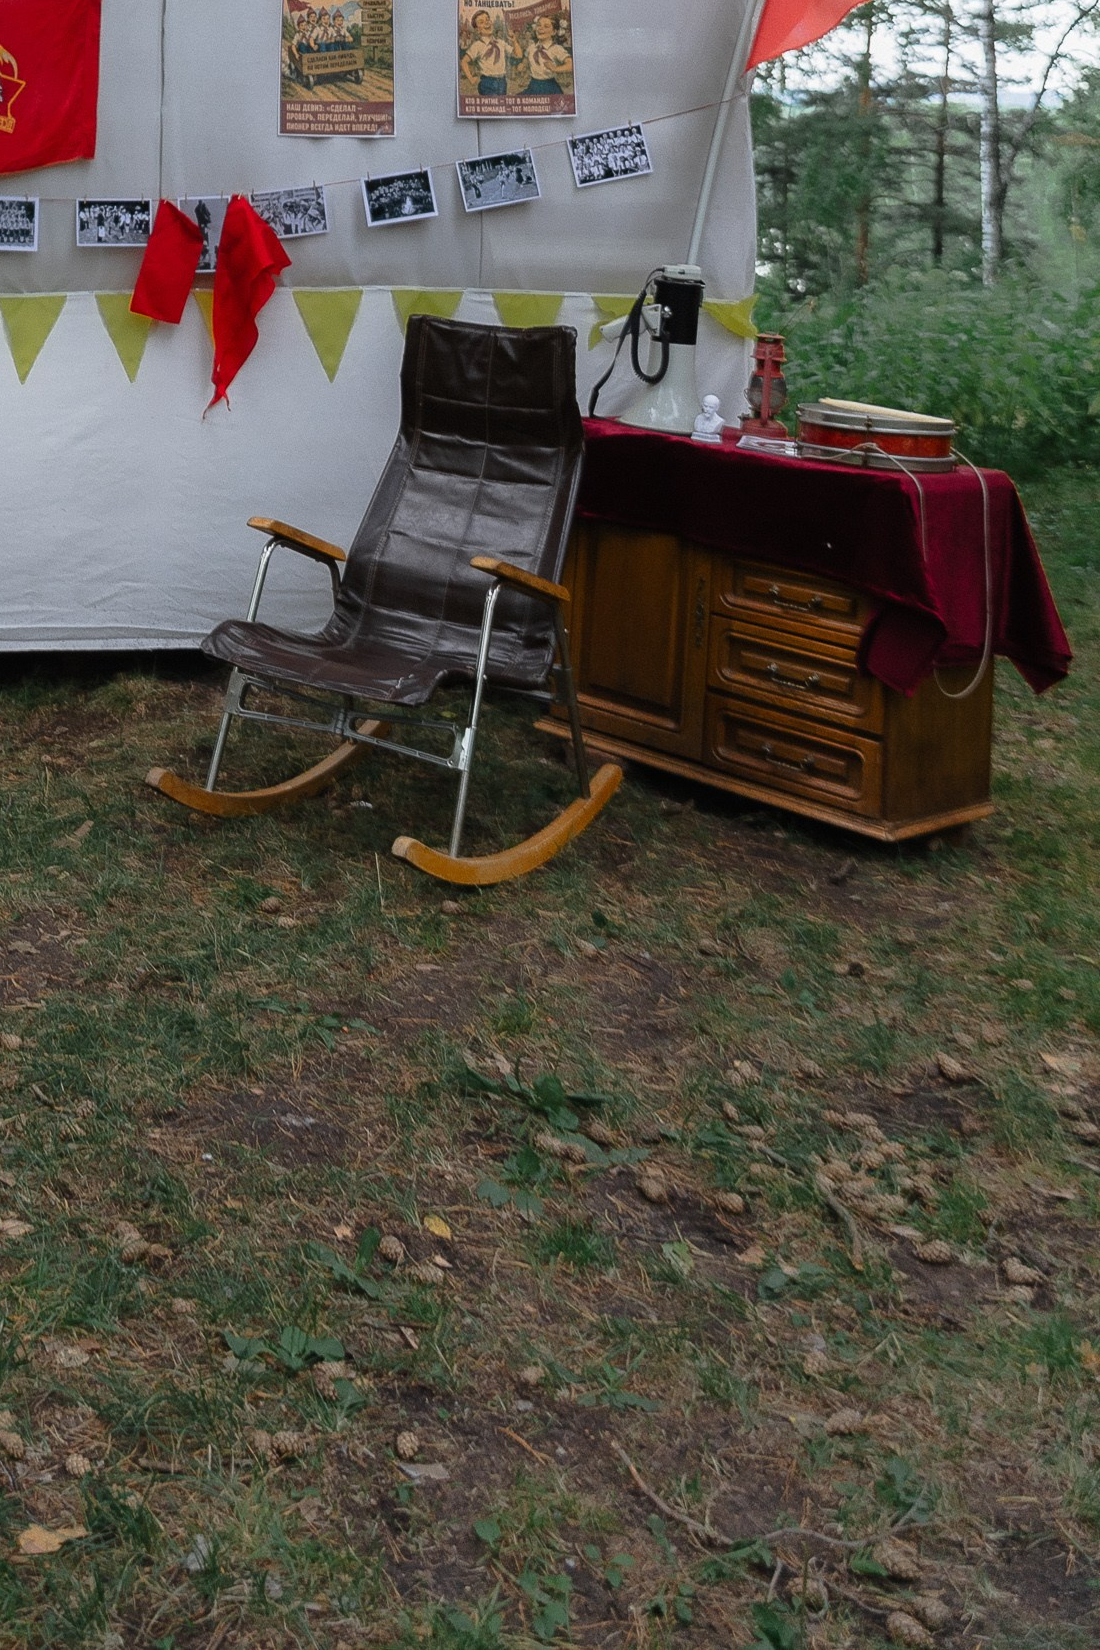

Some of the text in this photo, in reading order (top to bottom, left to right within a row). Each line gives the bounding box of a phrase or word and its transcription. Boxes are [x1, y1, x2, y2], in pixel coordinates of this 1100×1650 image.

[464, 0, 515, 8] НО ТАНЦЕВАТЬ!
[465, 97, 475, 105] КТО
[286, 103, 301, 111] НАШ
[302, 104, 325, 112] ДЕВИЗ:
[286, 122, 310, 130] ПИОНЕР
[310, 123, 334, 131] ВСЕГДА
